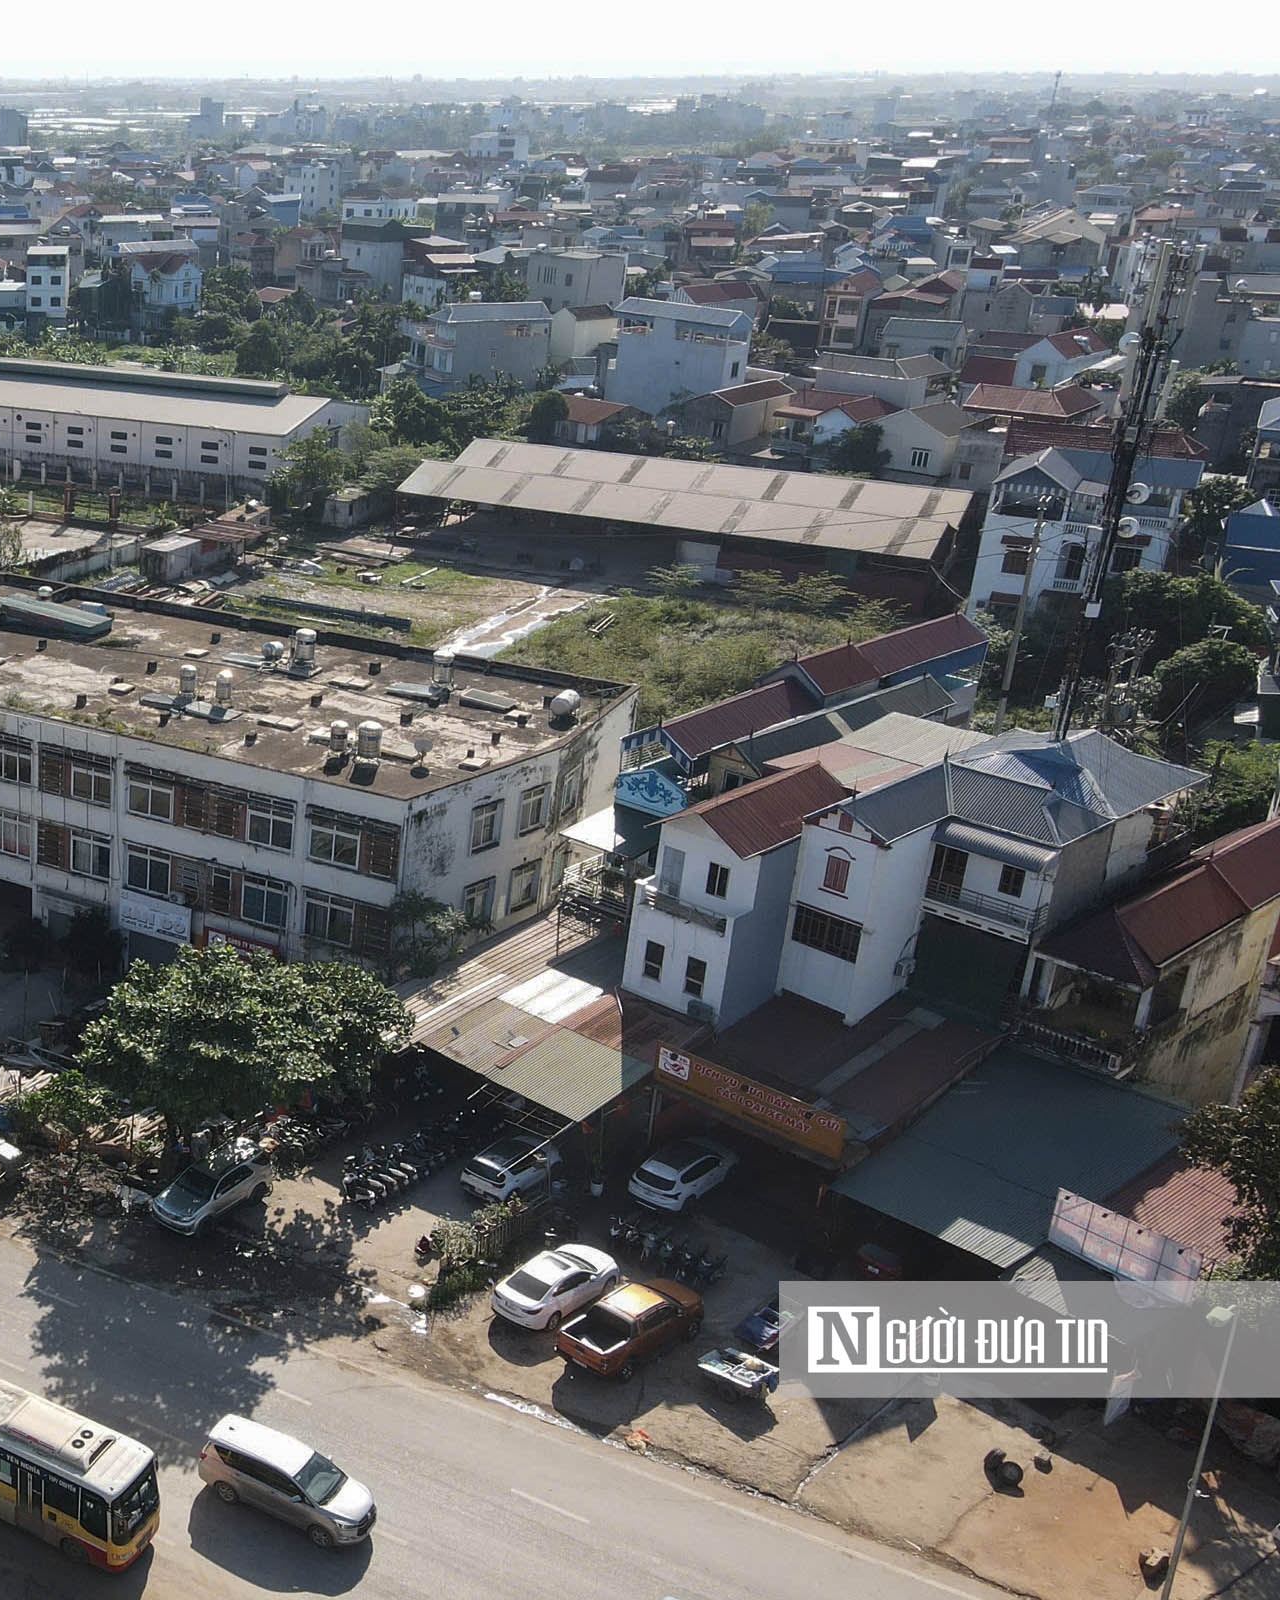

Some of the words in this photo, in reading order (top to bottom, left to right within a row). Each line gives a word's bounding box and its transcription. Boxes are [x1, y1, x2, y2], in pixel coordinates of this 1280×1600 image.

[694, 1063, 720, 1081] DỊCH
[739, 1081, 764, 1100] UA
[715, 1086, 736, 1102] CÁC
[738, 1096, 765, 1114] LOẠI
[767, 1109, 783, 1122] XE
[785, 1113, 813, 1133] MÁY
